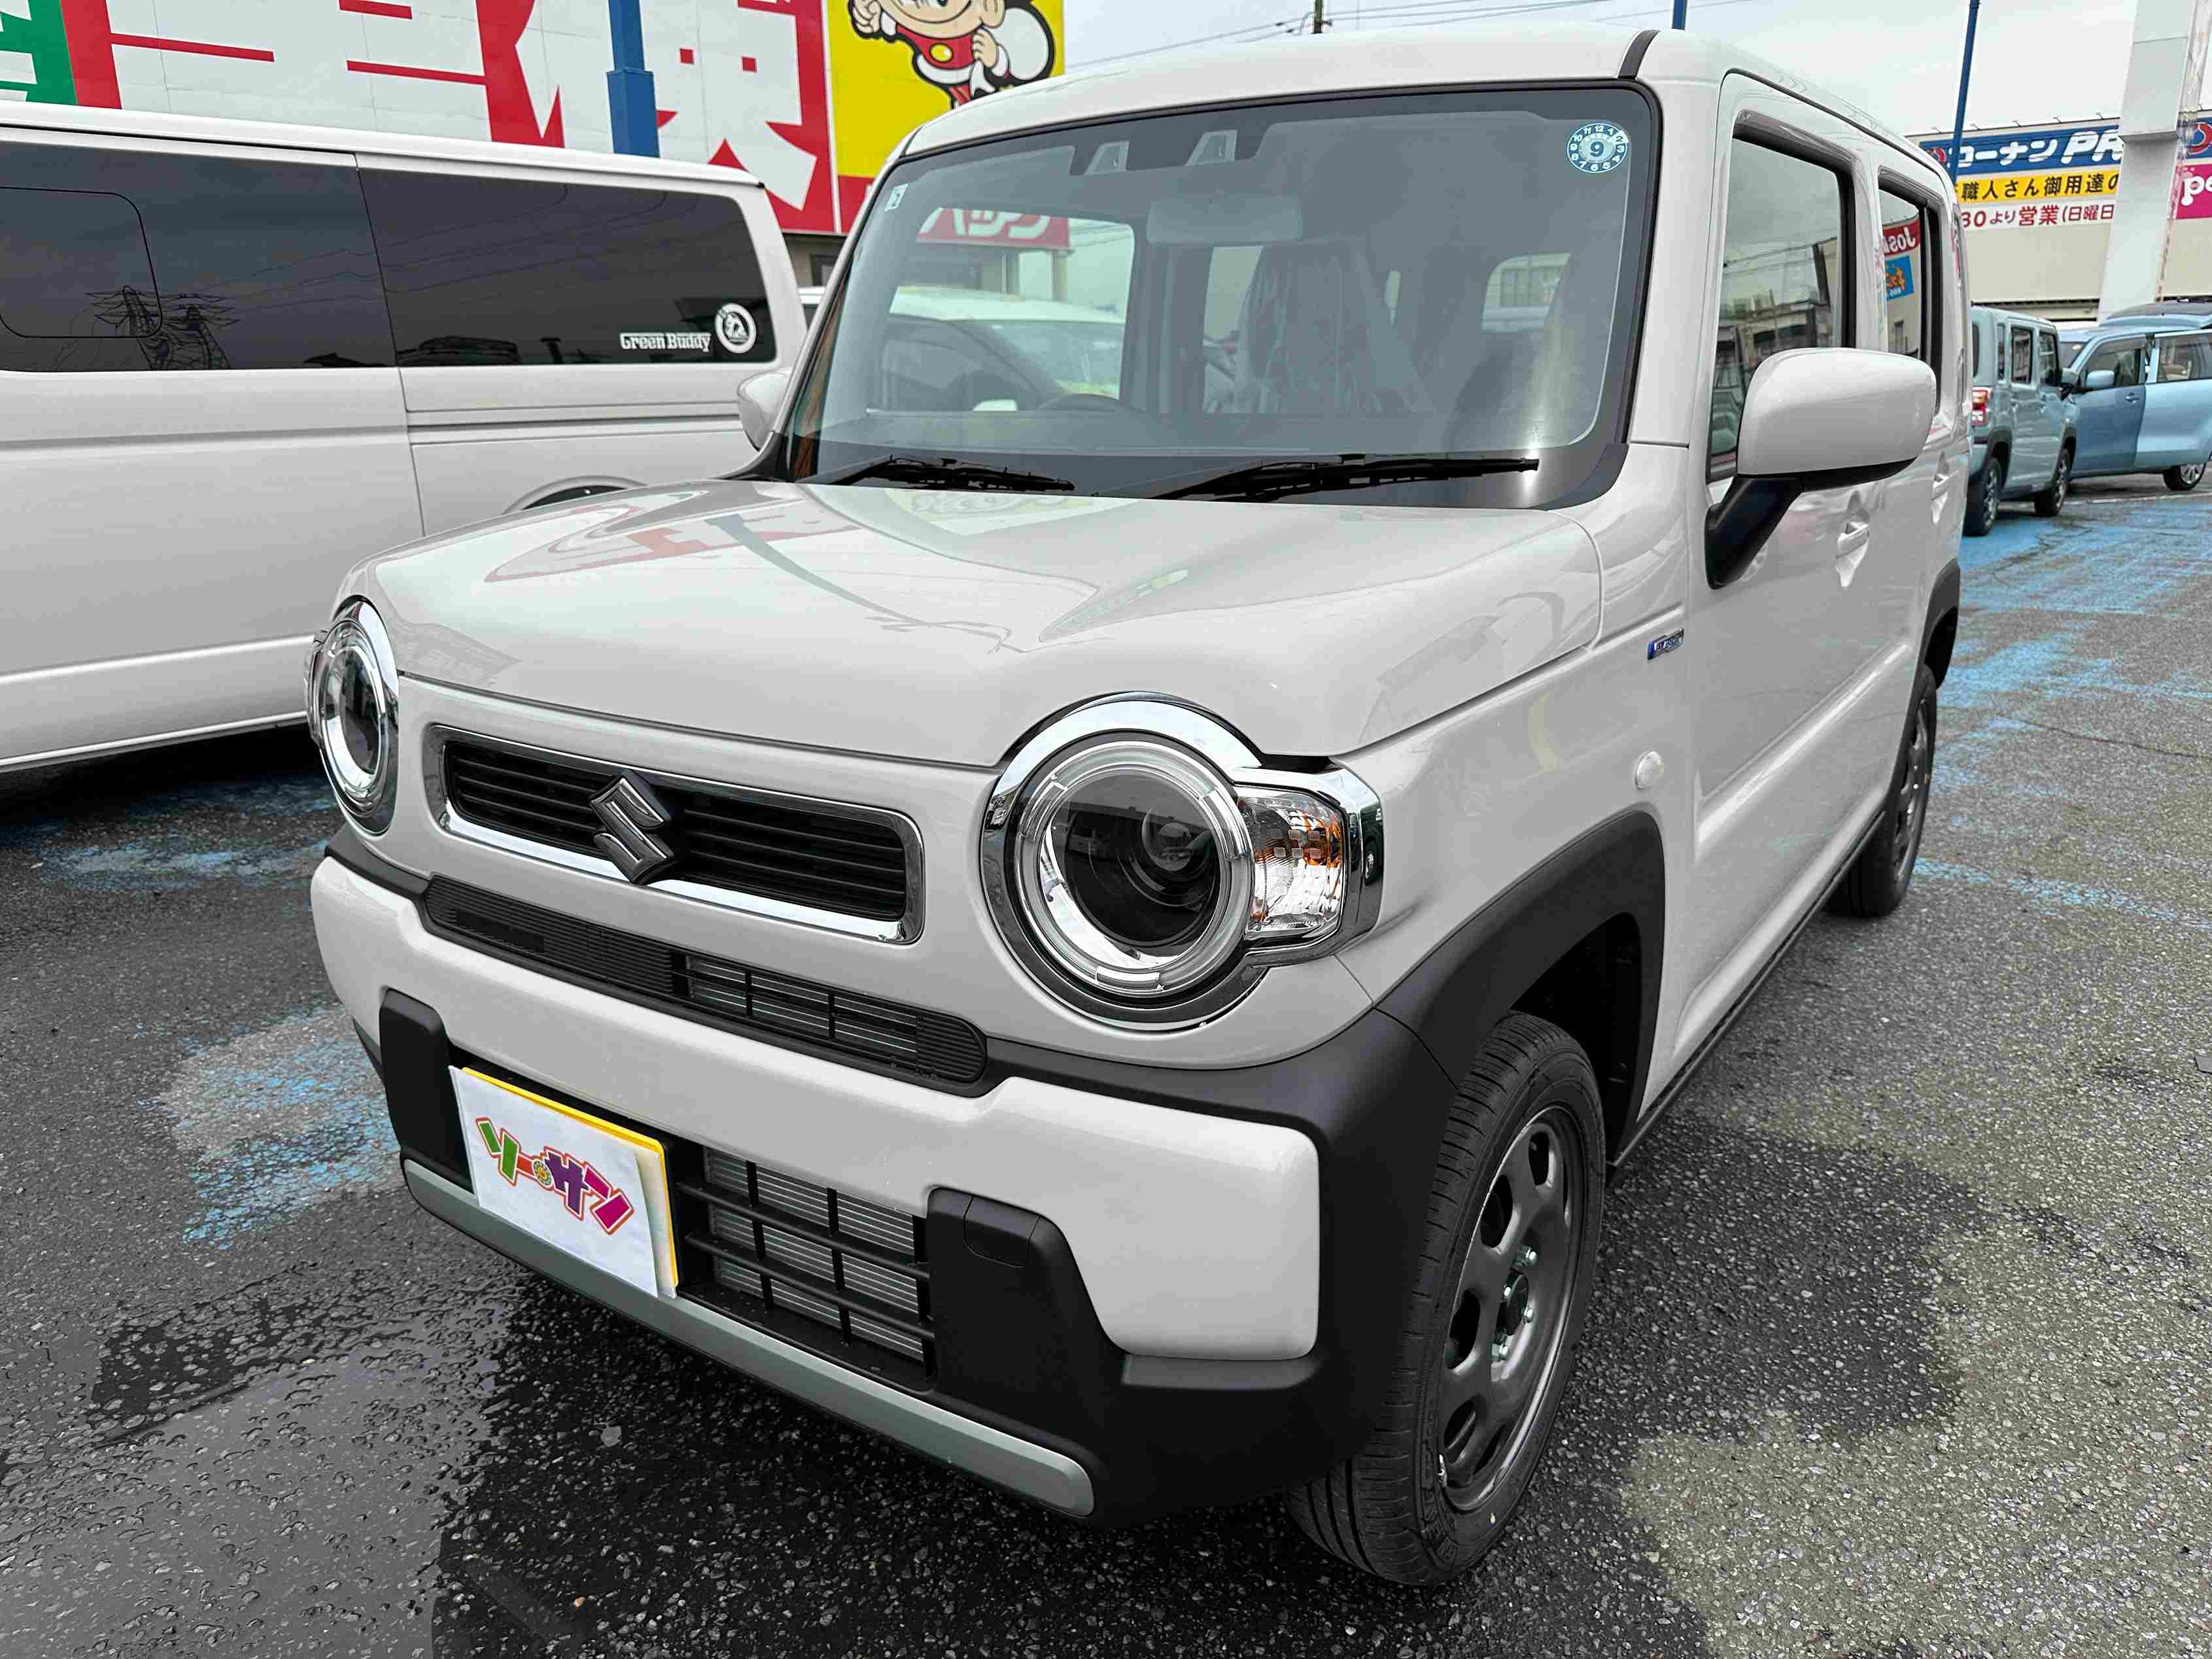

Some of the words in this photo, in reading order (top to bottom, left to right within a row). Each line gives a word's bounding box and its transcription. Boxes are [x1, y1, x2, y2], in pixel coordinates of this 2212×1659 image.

[1590, 141, 1604, 157] 9
[620, 332, 665, 351] Green
[666, 332, 712, 352] Buddy
